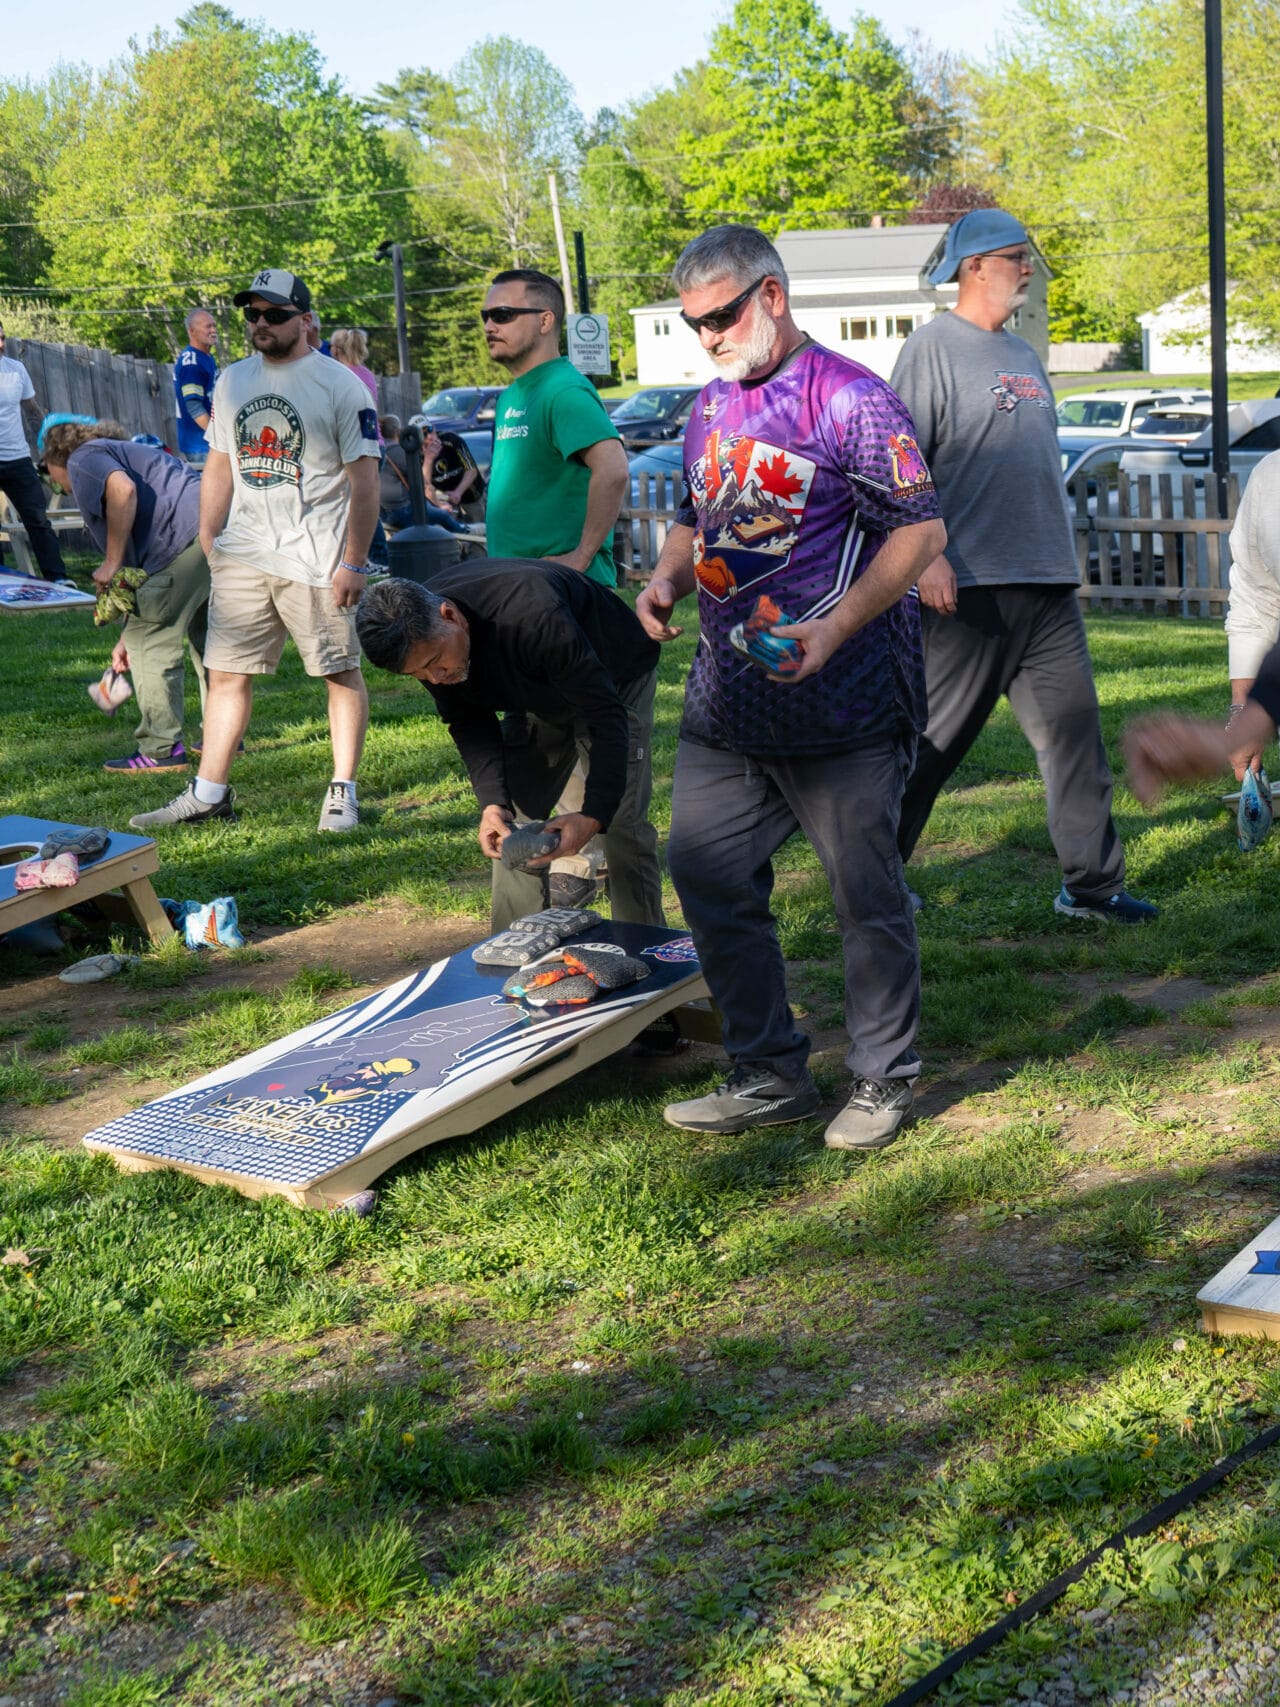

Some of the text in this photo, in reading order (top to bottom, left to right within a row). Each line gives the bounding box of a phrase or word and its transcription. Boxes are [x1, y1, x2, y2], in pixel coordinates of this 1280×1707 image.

[255, 272, 271, 287] NY
[182, 351, 197, 366] 21
[244, 397, 296, 419] MIDCOAST
[273, 459, 298, 476] CLUB
[894, 486, 915, 498] HIGH
